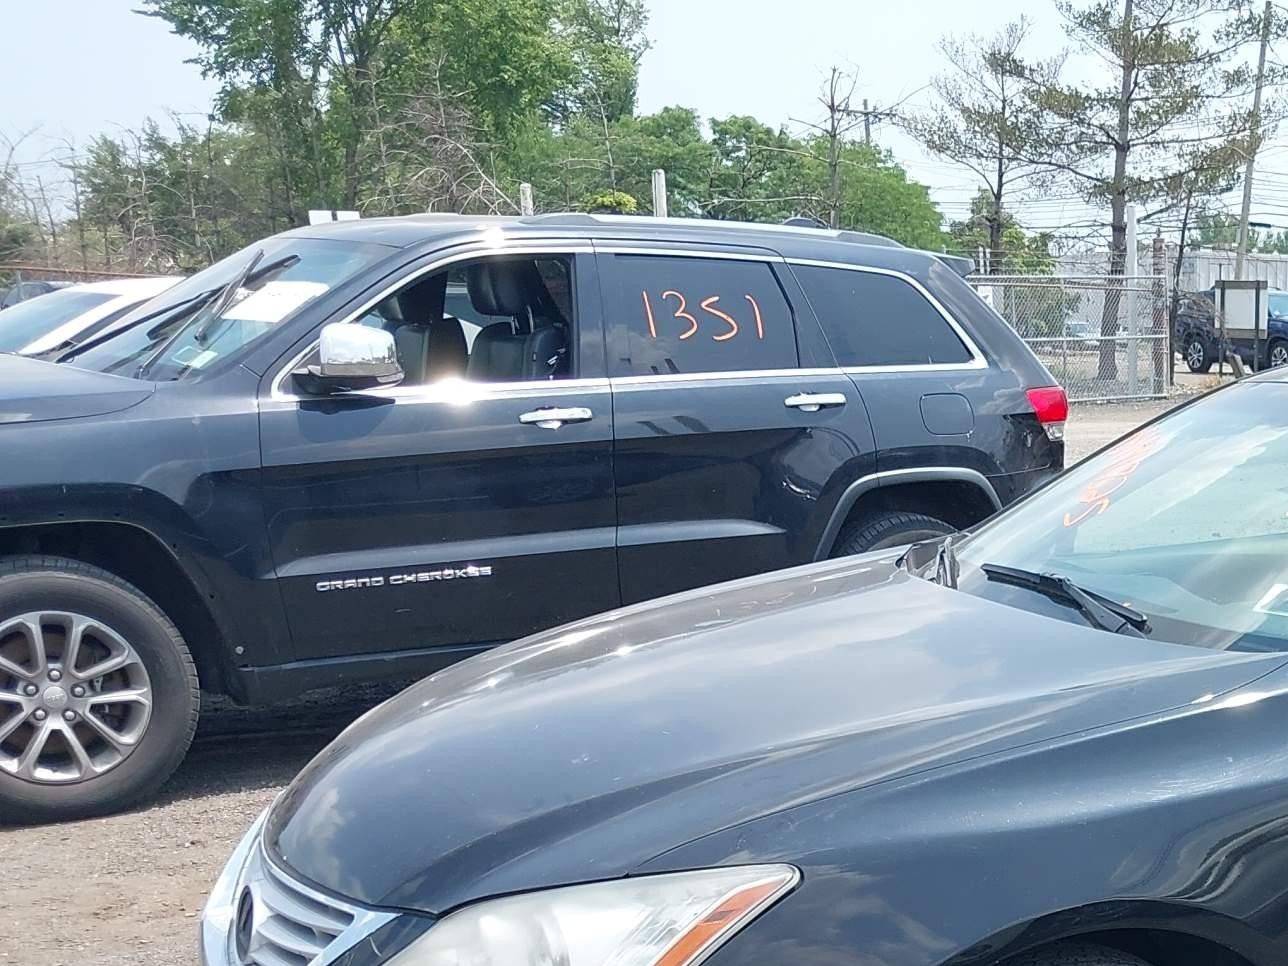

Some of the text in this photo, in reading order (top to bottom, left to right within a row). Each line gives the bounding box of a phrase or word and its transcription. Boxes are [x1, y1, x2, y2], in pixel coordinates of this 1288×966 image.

[642, 290, 764, 340] 1351
[316, 565, 492, 592] GRAND CHEROKEE
